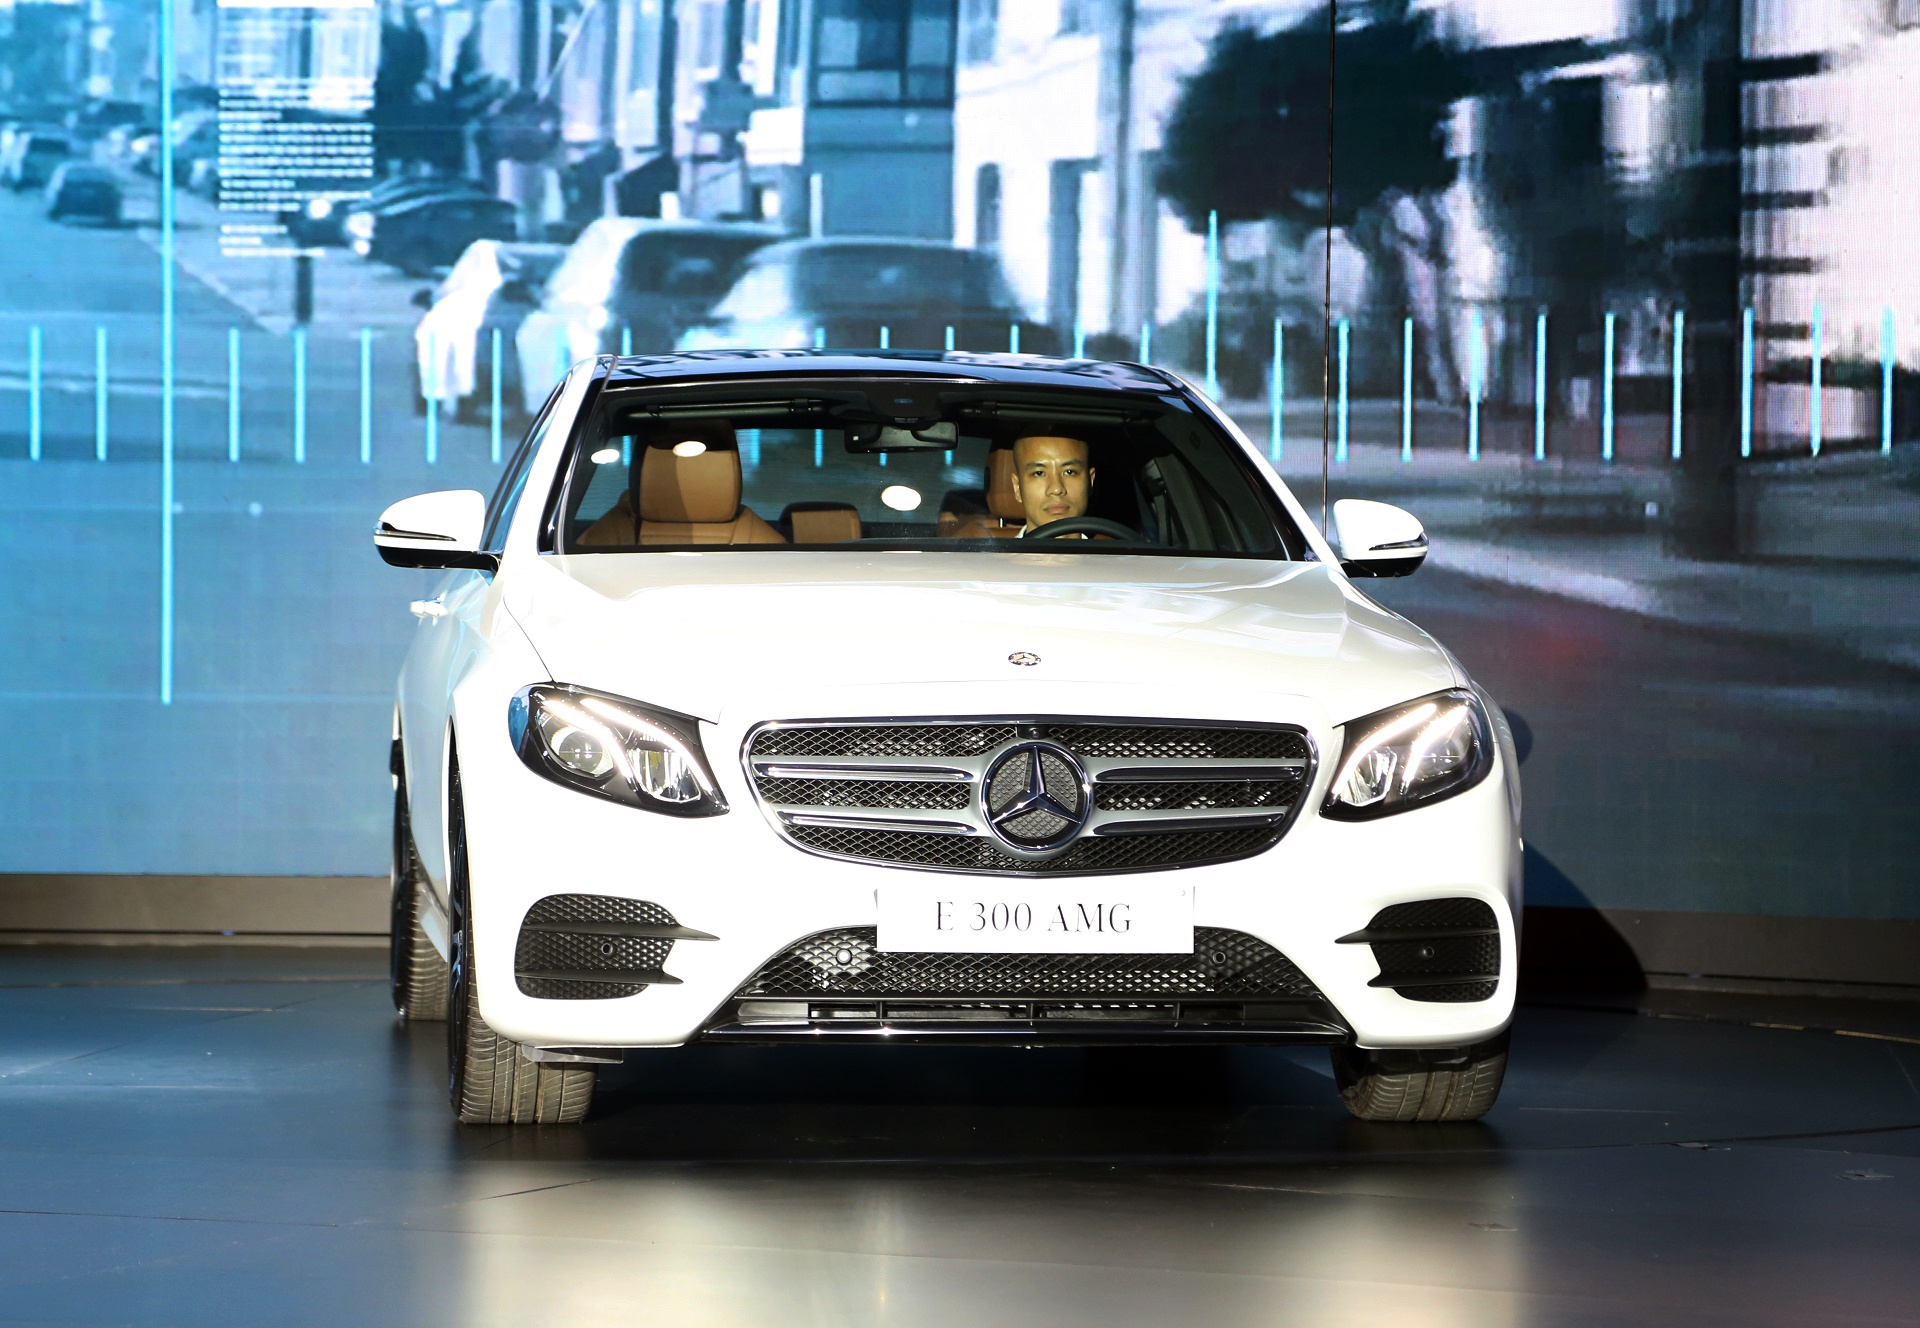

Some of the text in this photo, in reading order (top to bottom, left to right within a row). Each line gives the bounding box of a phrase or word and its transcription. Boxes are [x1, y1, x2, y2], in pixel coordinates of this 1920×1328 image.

[936, 901, 1131, 933] E 300 AMG
